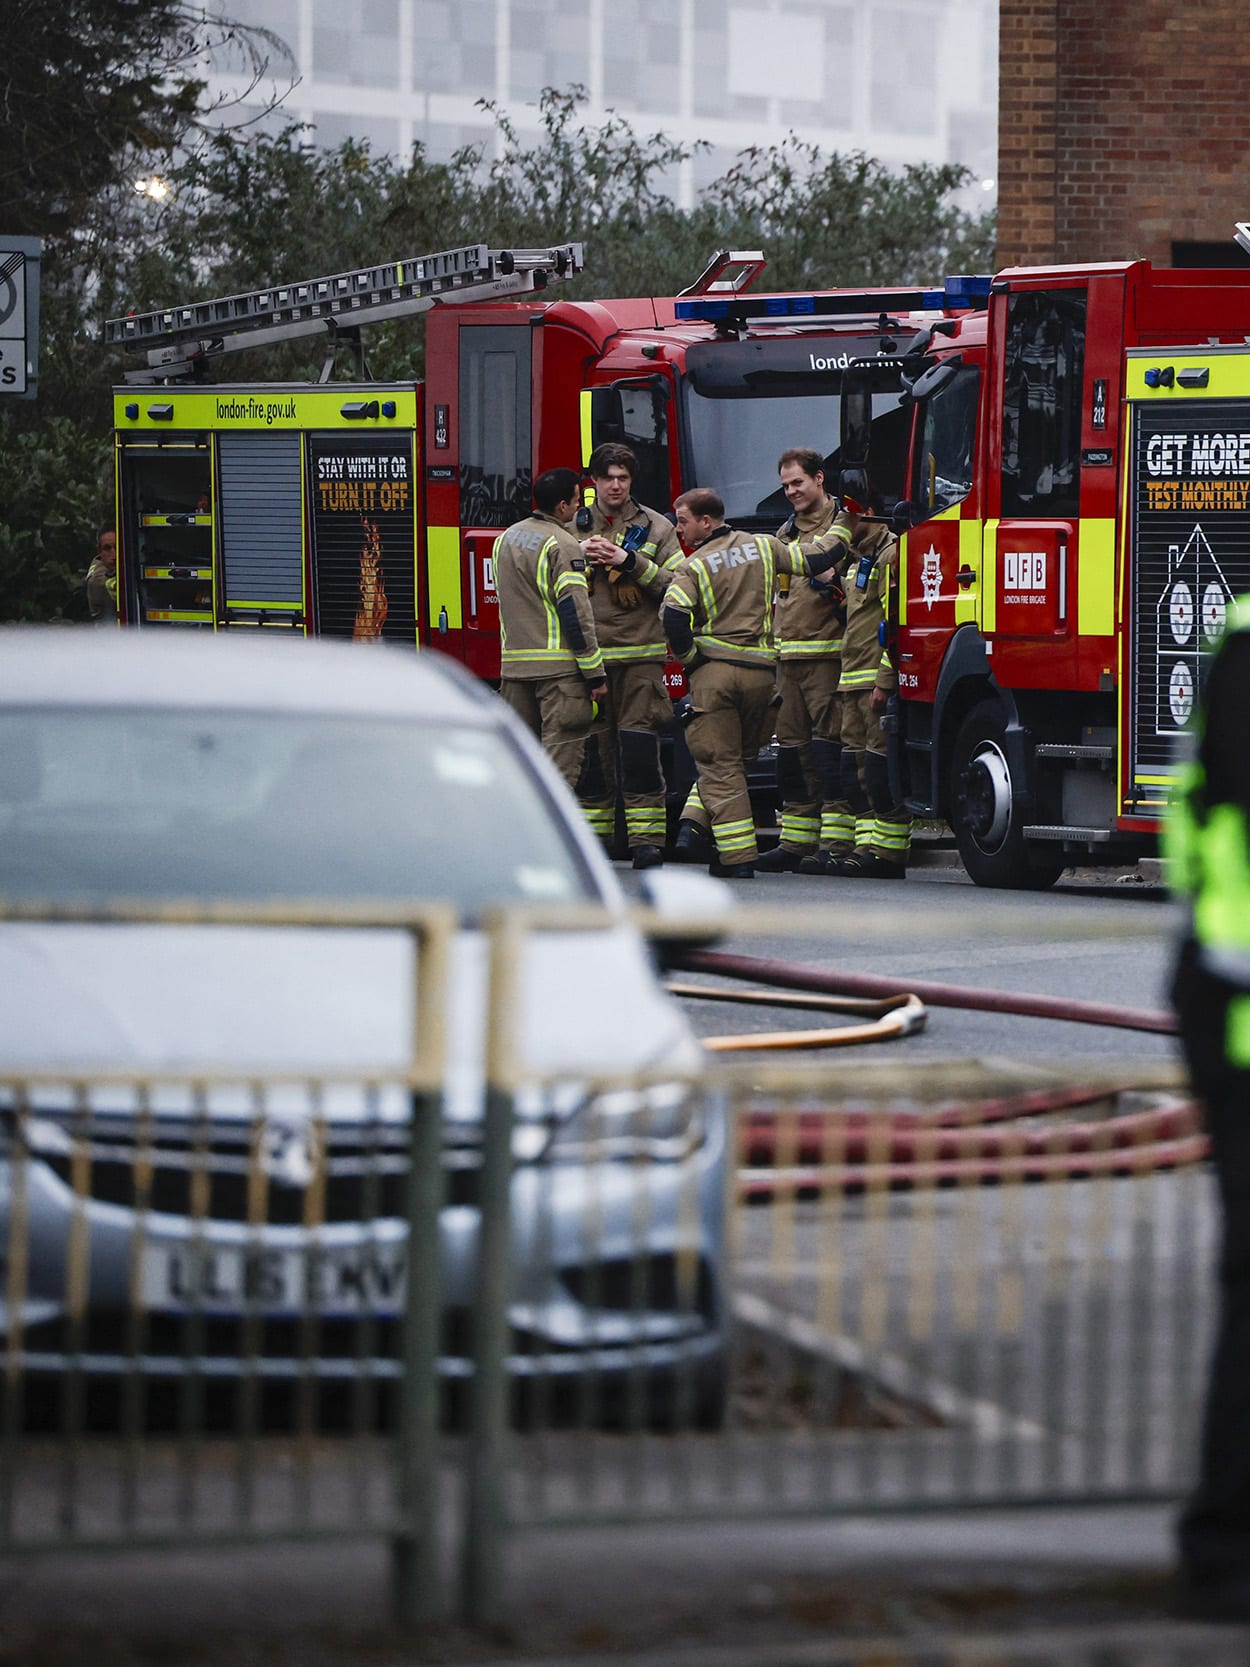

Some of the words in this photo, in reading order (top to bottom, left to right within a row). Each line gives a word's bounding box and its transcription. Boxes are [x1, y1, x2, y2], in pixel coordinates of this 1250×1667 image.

[1097, 386, 1103, 402] A
[216, 397, 297, 425] london-fire.gov.uk
[1093, 406, 1105, 423] 212
[318, 457, 345, 479] STAY
[346, 457, 376, 479] WITH
[378, 457, 389, 479] IT
[391, 456, 408, 479] OR
[1146, 434, 1188, 476] GET
[319, 482, 360, 511] TURN
[362, 482, 377, 511] IT
[380, 482, 408, 512] OFF
[1146, 481, 1179, 509] TEST
[1181, 481, 1250, 509] MONTHLY
[706, 542, 761, 574] FIRE
[1007, 557, 1044, 584] LFB
[670, 674, 683, 686] 269
